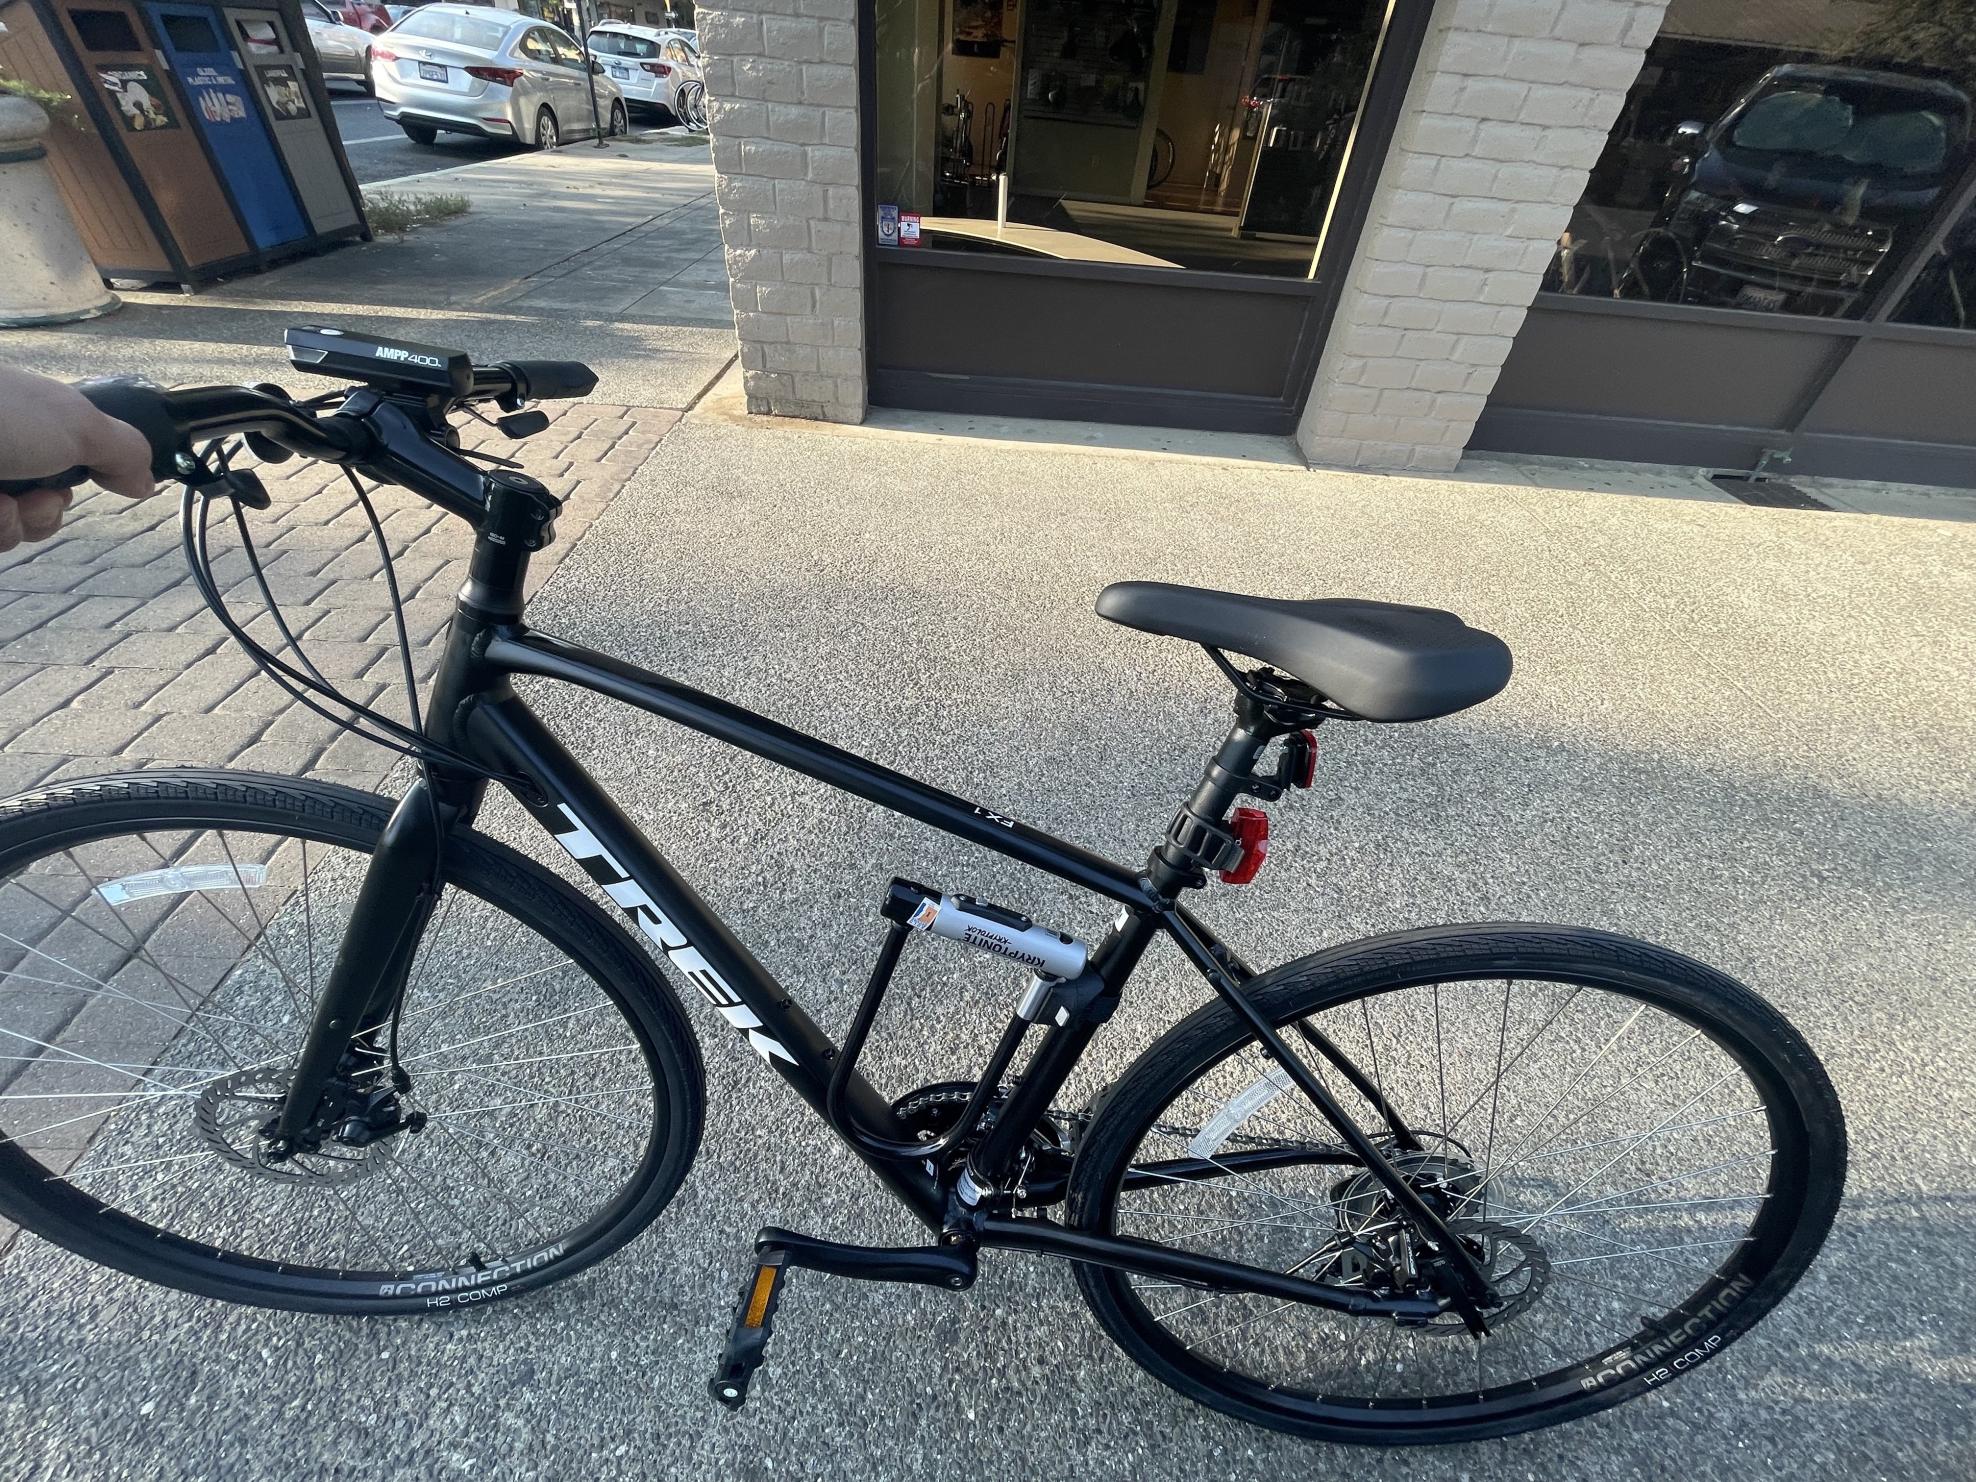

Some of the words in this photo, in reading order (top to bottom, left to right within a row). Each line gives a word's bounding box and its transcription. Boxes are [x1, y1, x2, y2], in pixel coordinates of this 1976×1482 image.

[554, 802, 800, 1068] TREK
[964, 932, 1046, 968] KRYPTONITE
[395, 1243, 565, 1296] CONNECTION
[426, 1295, 451, 1308] H2
[457, 1284, 508, 1304] COMP
[1596, 1272, 1755, 1387] CONNECTION
[1643, 1367, 1671, 1386] H2
[1673, 1334, 1722, 1371] COMP
